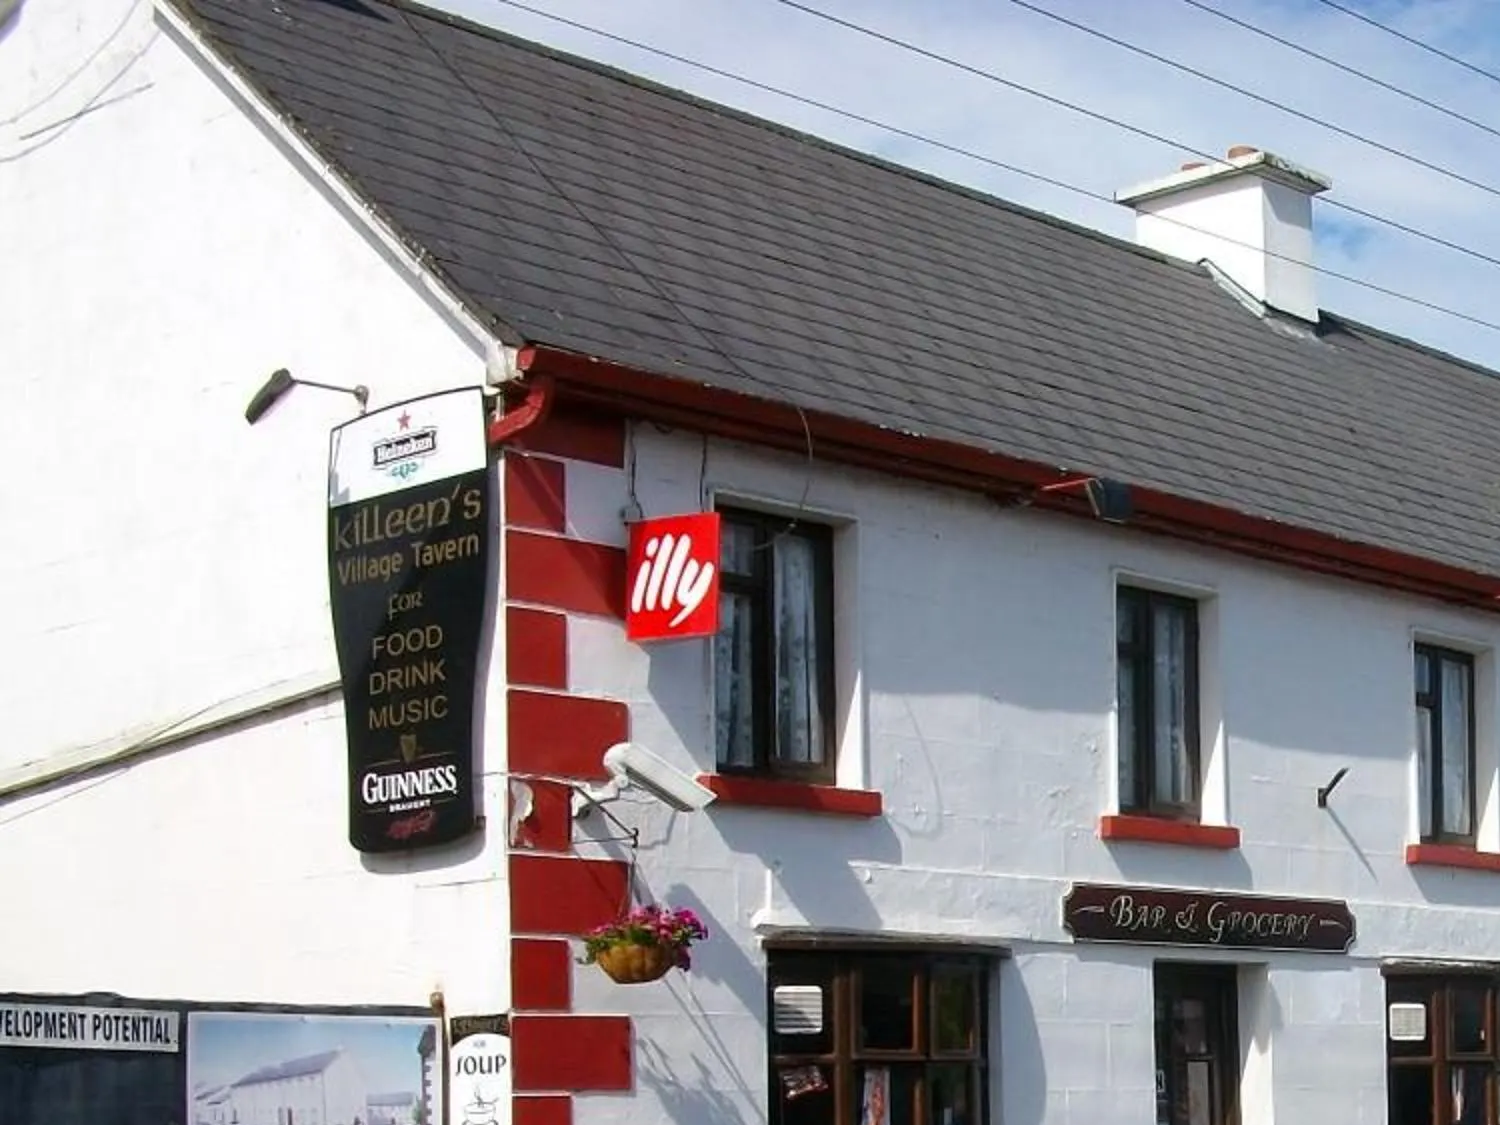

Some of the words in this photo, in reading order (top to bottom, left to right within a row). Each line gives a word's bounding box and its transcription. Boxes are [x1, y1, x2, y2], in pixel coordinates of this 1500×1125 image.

[338, 551, 403, 585] Village
[411, 533, 479, 568] Tavern
[632, 533, 715, 628] illy
[372, 625, 444, 660] FOOD
[370, 658, 446, 694] DRINK
[369, 695, 448, 729] MUSIC
[362, 764, 458, 804] GUINNESS
[1109, 895, 1170, 932] BAR
[1207, 901, 1314, 942] GROCERY
[93, 1013, 171, 1044] POTENTIAL
[455, 1053, 507, 1076] SOUP
